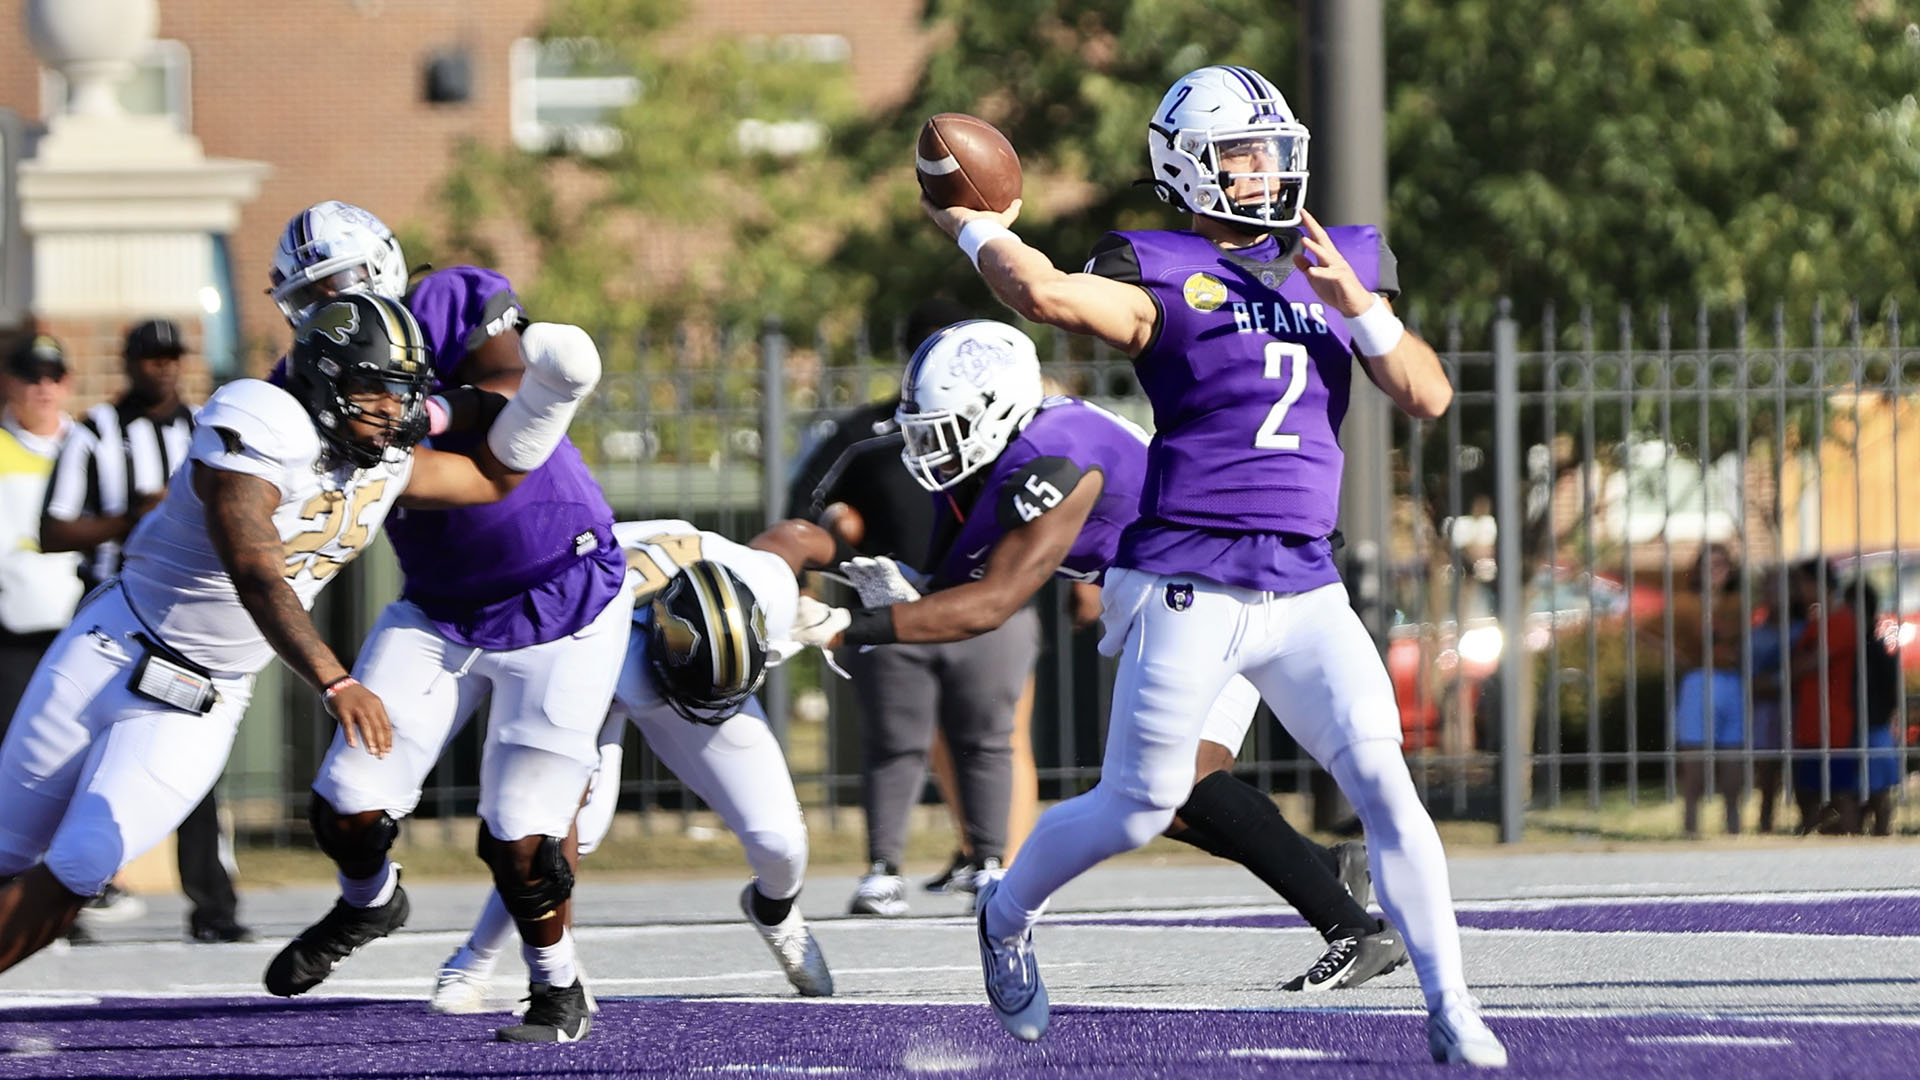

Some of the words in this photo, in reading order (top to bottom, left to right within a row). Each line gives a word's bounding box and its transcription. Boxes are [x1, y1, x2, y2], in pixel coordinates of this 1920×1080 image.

[1164, 85, 1193, 125] 2
[1232, 301, 1329, 335] BEARS
[1254, 341, 1309, 450] 2
[1013, 474, 1064, 522] 45
[283, 478, 387, 580] 25
